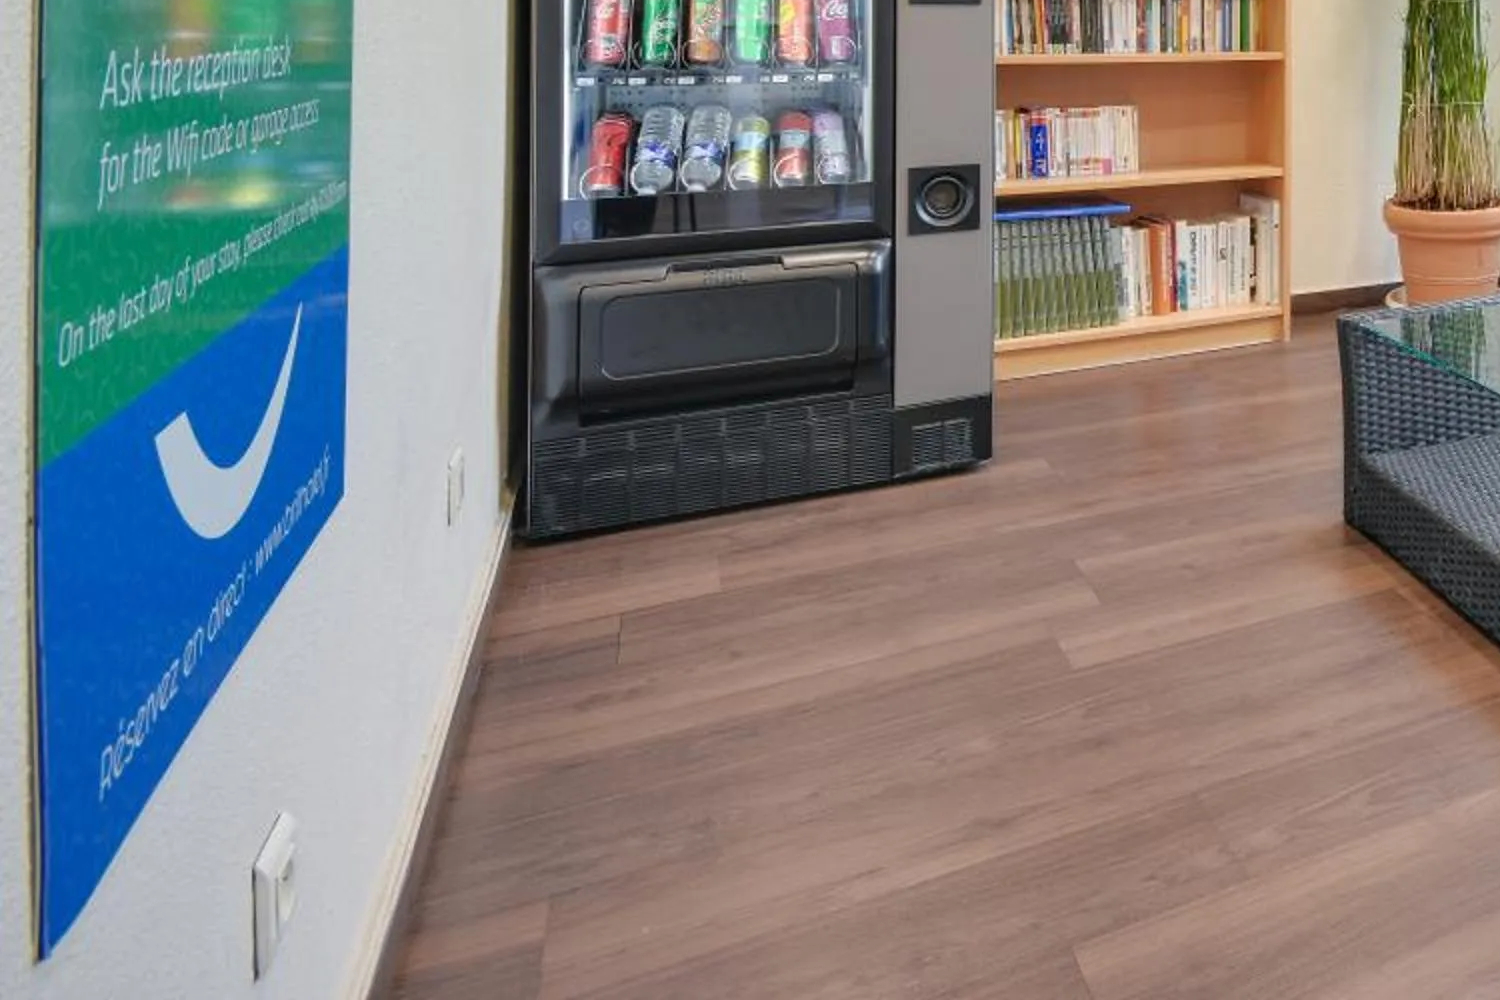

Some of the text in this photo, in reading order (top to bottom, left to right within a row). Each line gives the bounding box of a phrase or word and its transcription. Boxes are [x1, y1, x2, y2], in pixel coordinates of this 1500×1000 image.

[100, 34, 291, 110] Ask the reception desk
[97, 140, 128, 210] for
[133, 133, 162, 186] the
[167, 124, 198, 178] Wifi
[202, 114, 233, 162] code
[236, 117, 249, 149] or
[250, 108, 288, 153] garage
[59, 317, 83, 367] On
[89, 299, 114, 349] the
[119, 284, 146, 332] last
[149, 267, 173, 319] day
[176, 256, 191, 304] of
[190, 250, 215, 296] your
[98, 659, 179, 801] Réservez
[183, 625, 204, 677] en
[207, 568, 247, 643] direct
